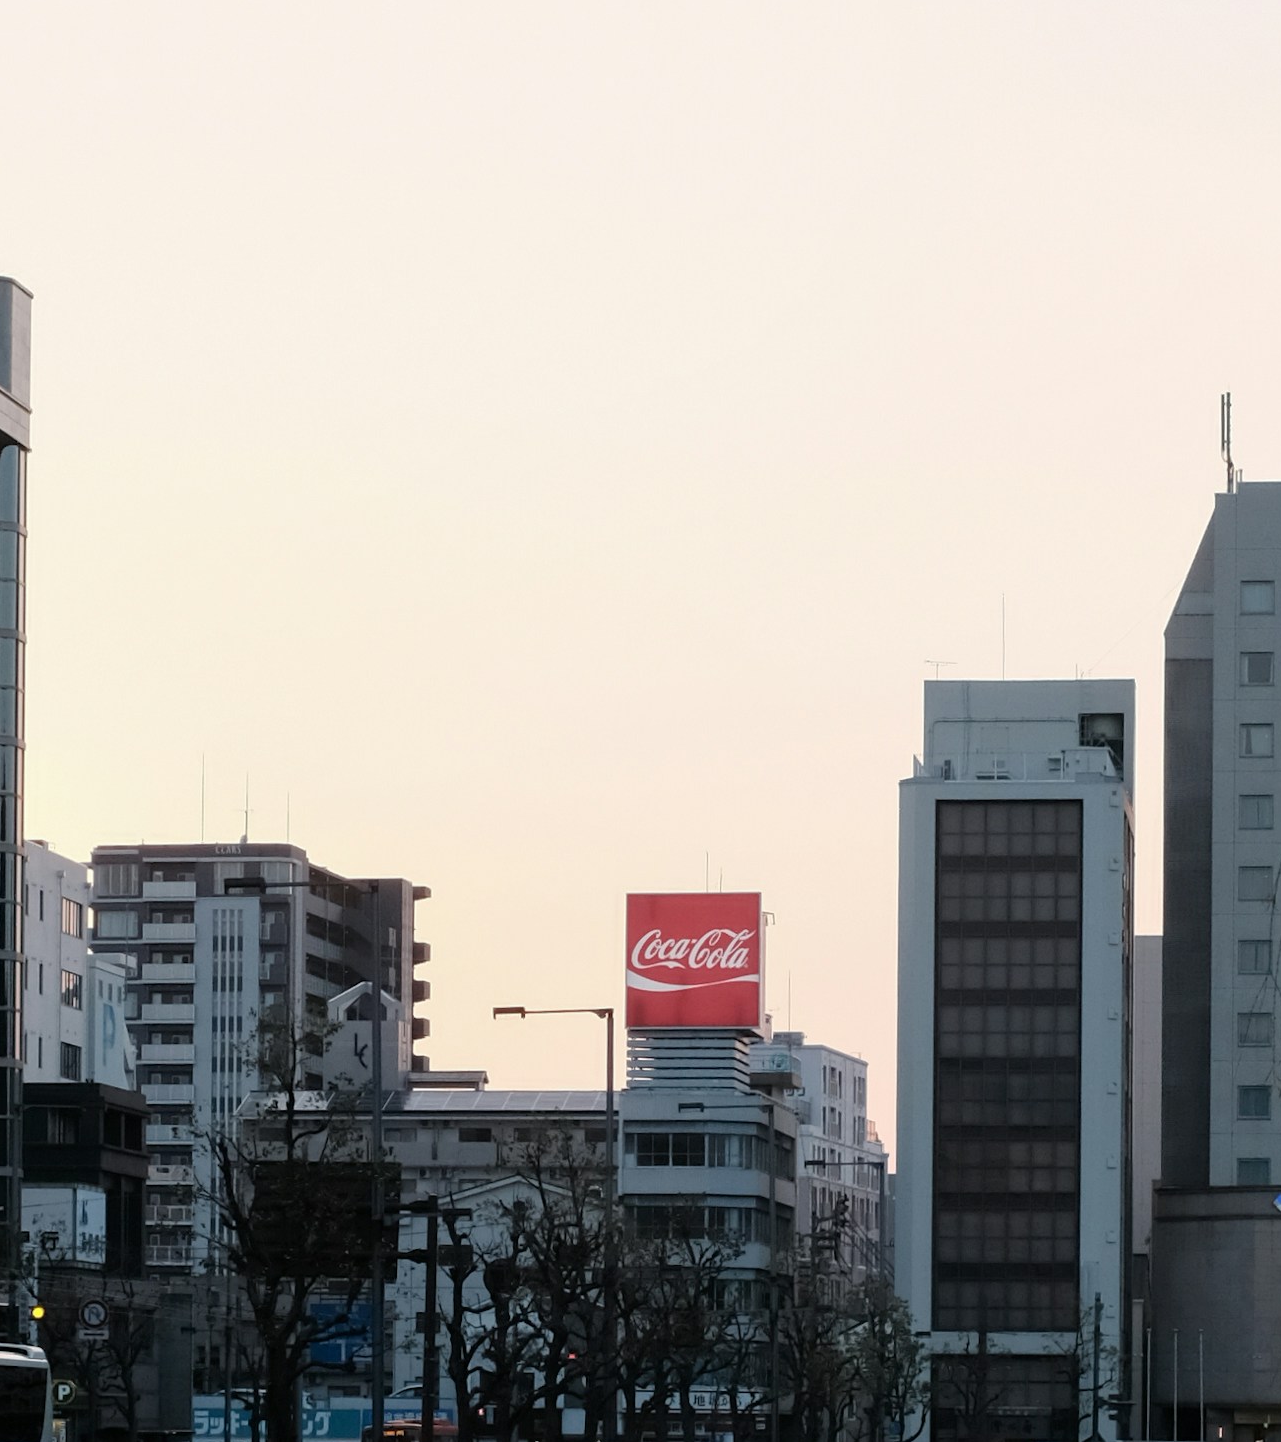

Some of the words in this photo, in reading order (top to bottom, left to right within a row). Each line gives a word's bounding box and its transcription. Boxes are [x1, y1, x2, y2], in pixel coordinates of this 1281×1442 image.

[631, 929, 756, 969] Coca-Cola
[57, 1384, 70, 1400] P
[193, 1410, 331, 1436] ラッキーング
